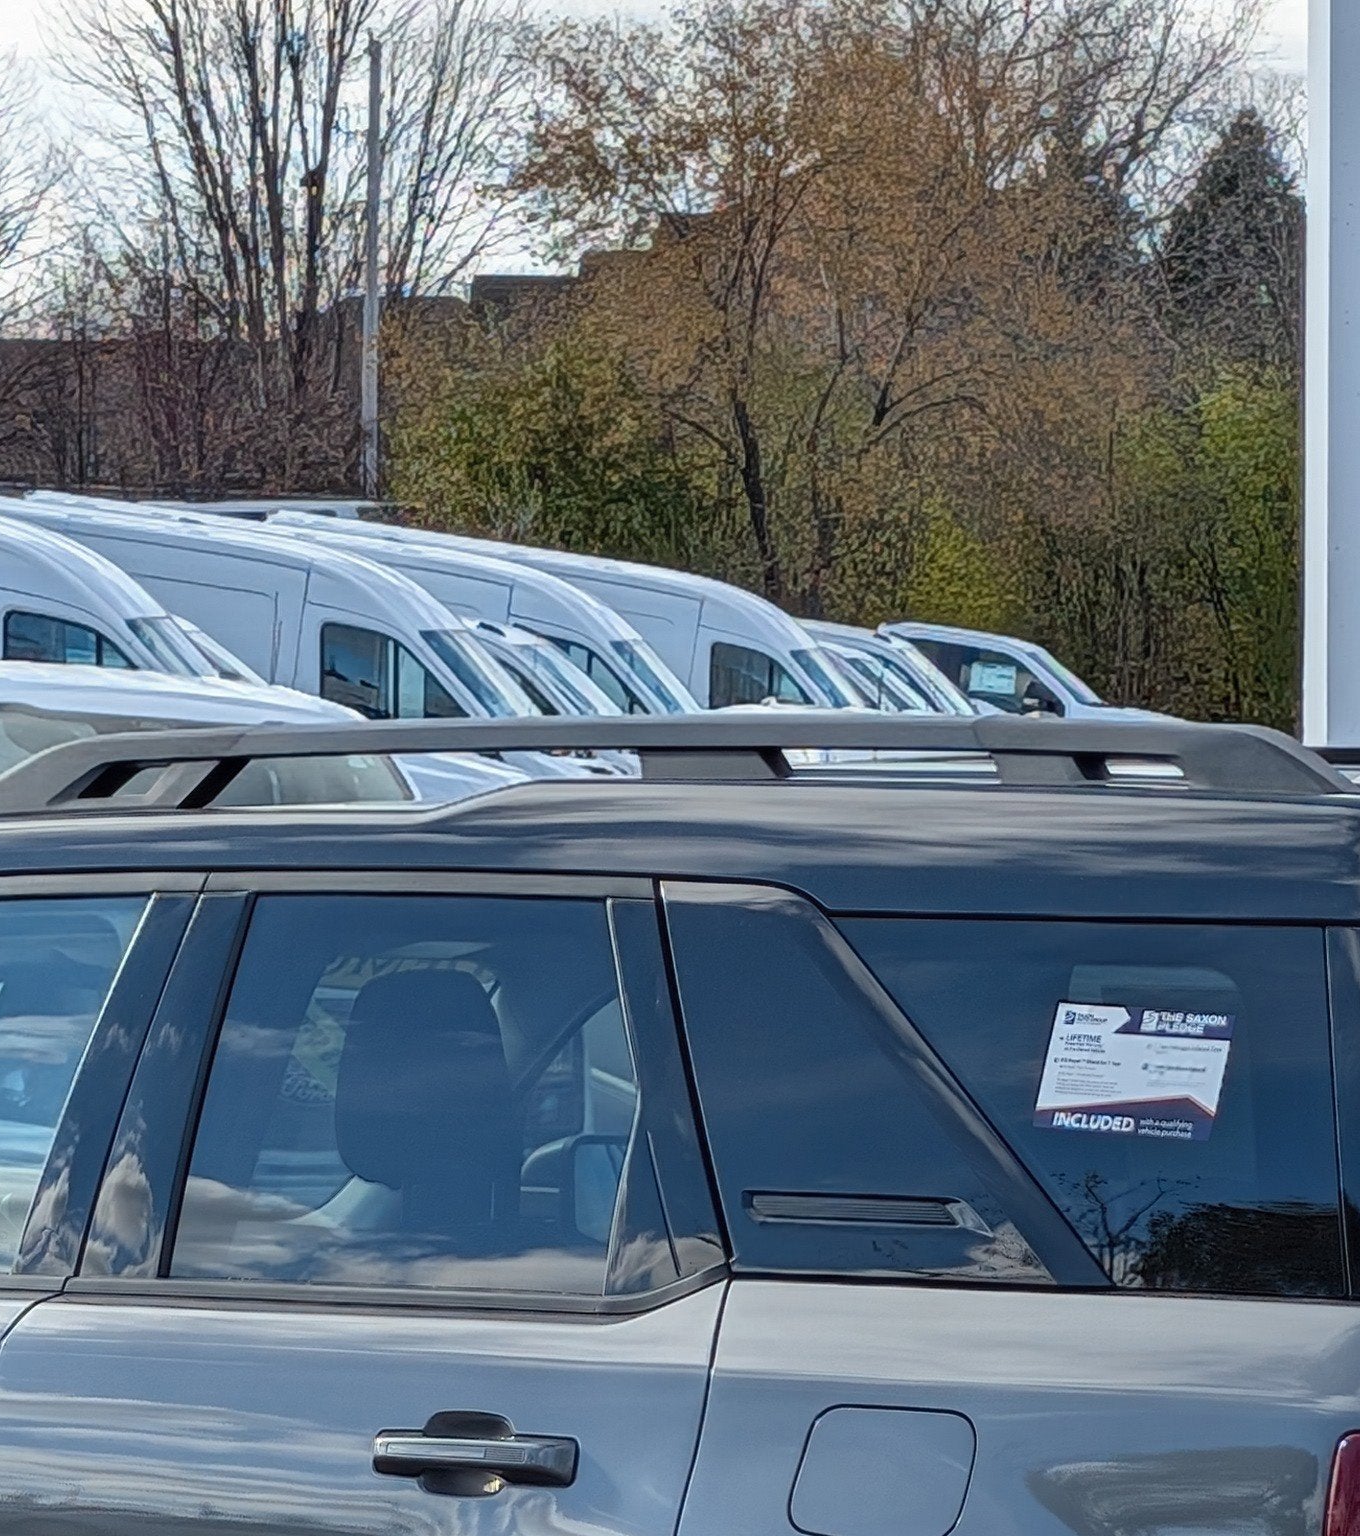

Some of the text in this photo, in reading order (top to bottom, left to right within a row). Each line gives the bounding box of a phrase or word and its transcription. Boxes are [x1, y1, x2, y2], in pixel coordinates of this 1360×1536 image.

[1160, 1011, 1228, 1026] THE SAXON
[1156, 1021, 1205, 1034] PLEDGE
[1065, 1033, 1102, 1043] LIFETIME
[1052, 1111, 1135, 1132] INCLUDED
[1160, 1119, 1194, 1131] qualifying
[1137, 1127, 1192, 1139] vehicle purchase
